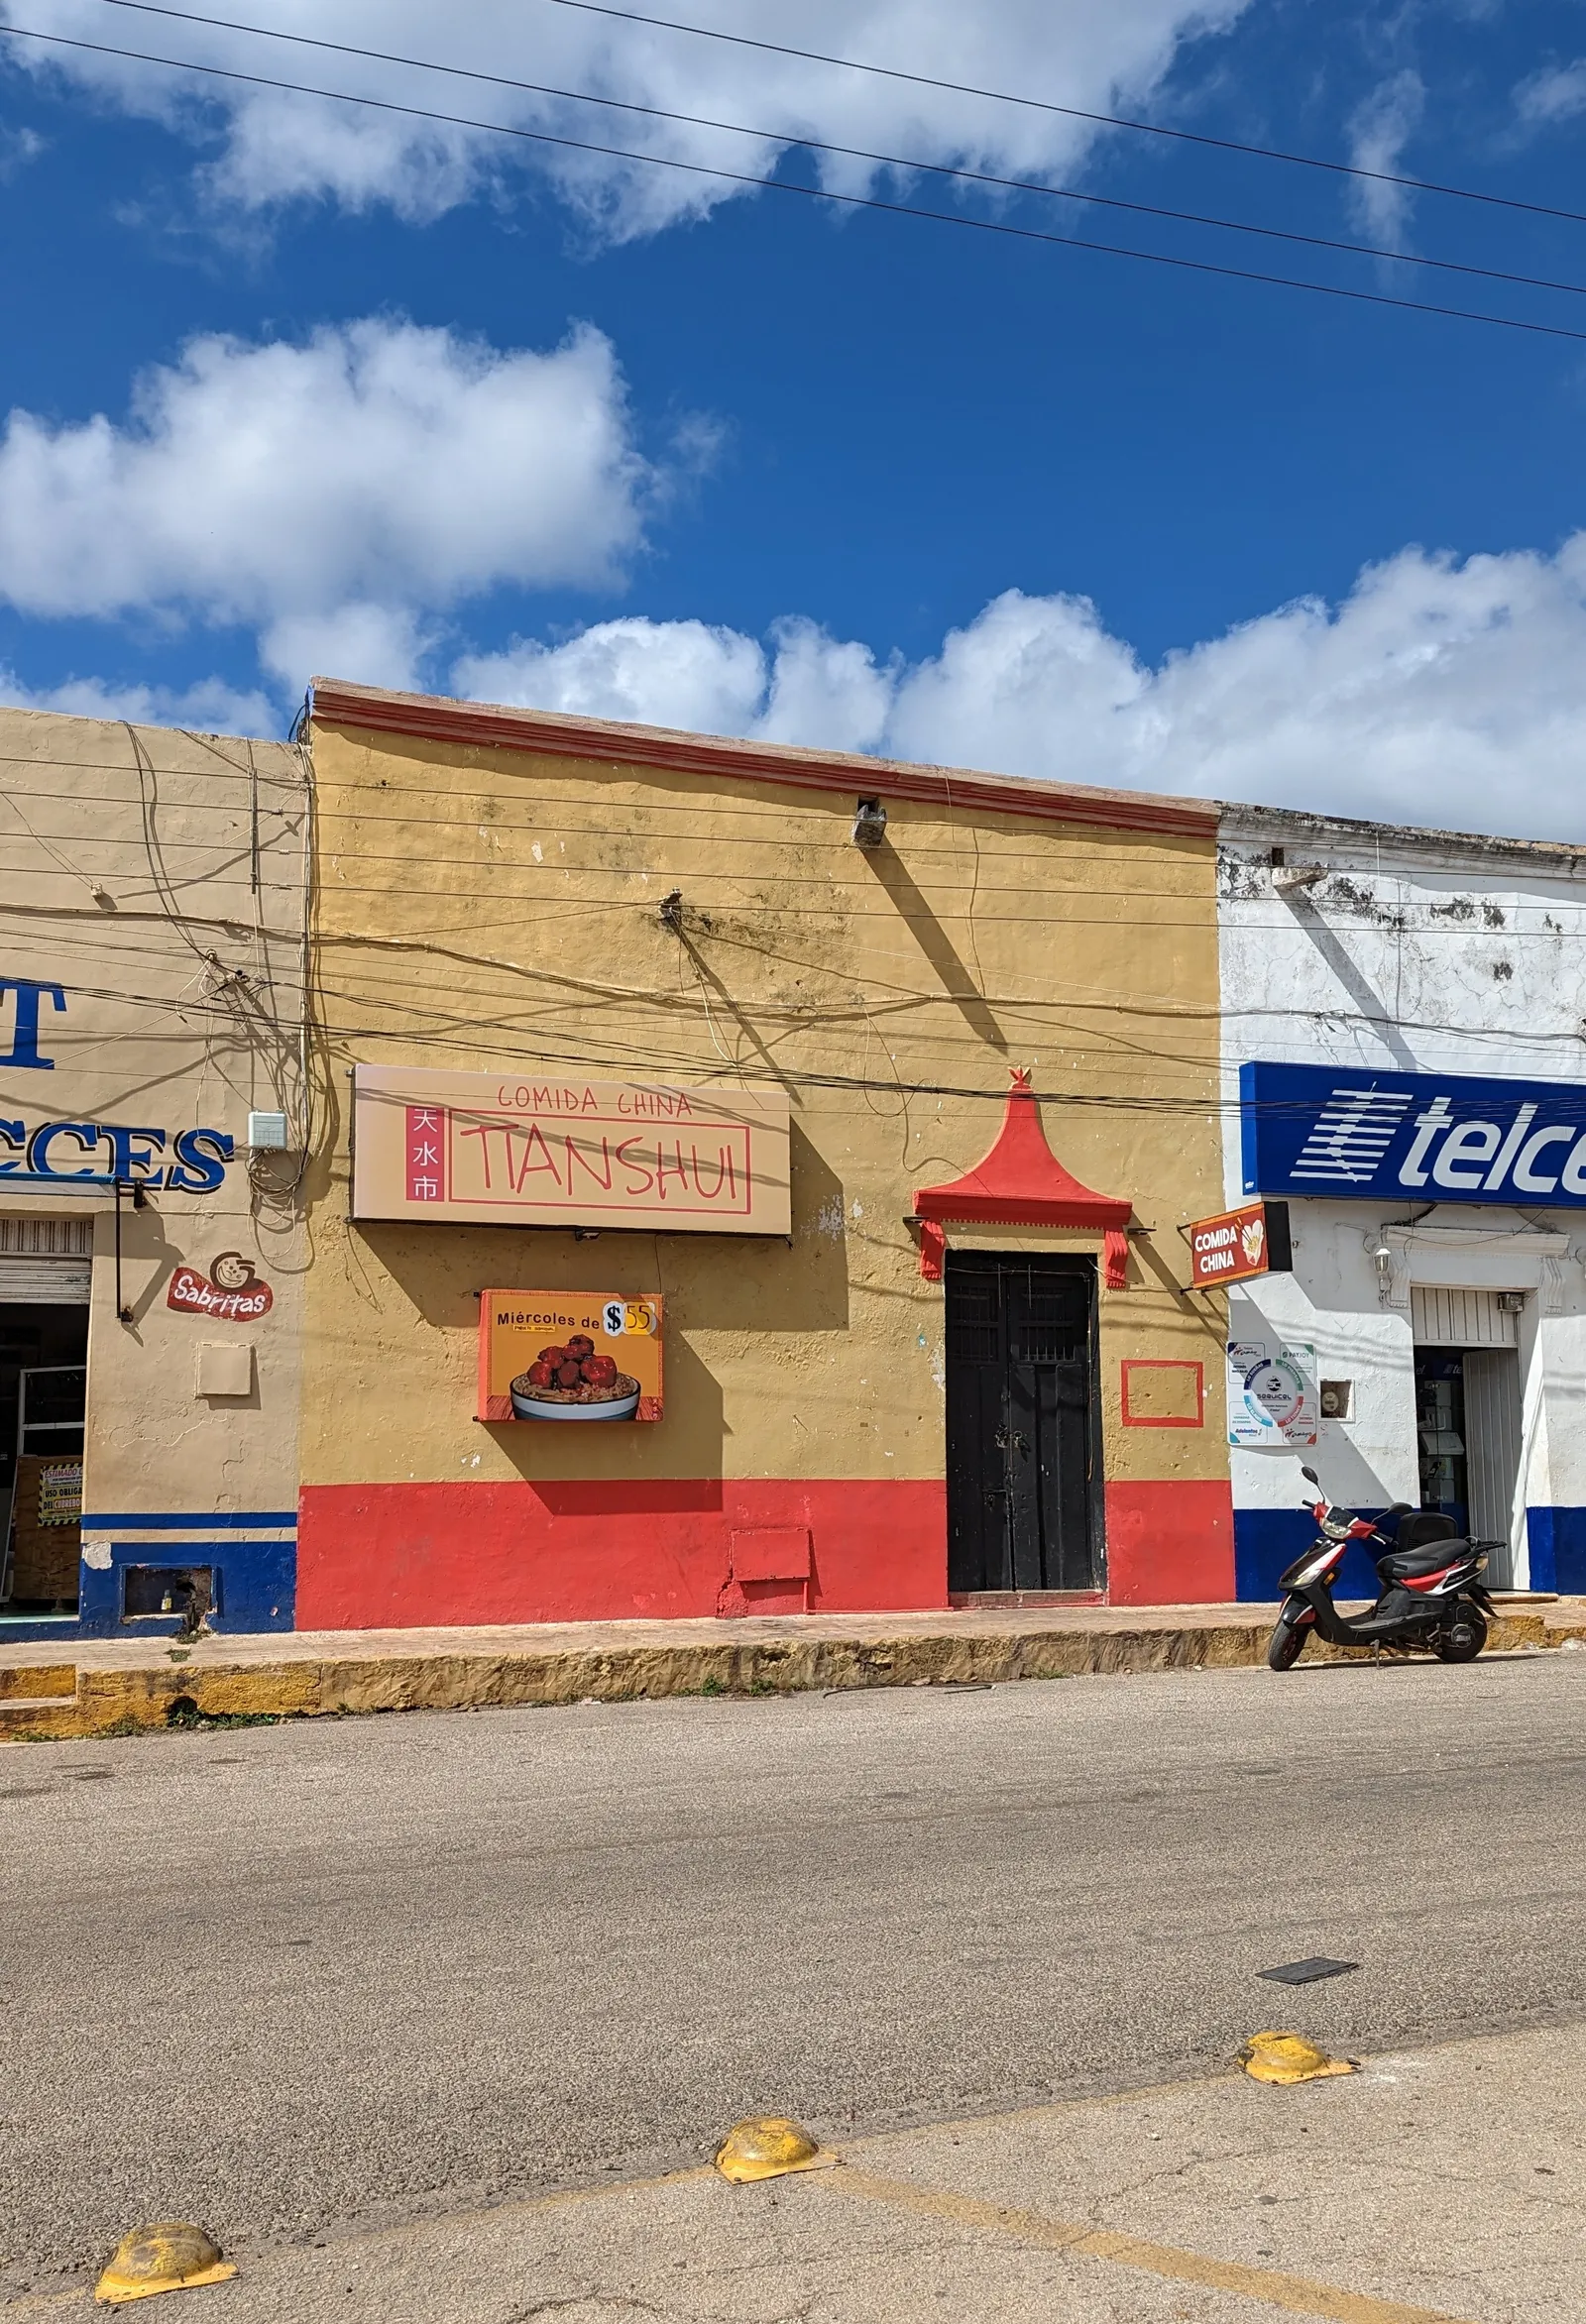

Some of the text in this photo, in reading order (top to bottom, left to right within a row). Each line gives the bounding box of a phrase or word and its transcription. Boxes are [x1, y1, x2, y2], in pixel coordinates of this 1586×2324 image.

[498, 1085, 692, 1118] COMIDA CHINA
[412, 1107, 438, 1201] 天水市
[460, 1123, 736, 1200] TIANSHUI
[1194, 1225, 1238, 1253] COMIDA
[1200, 1249, 1235, 1273] CHINA
[173, 1274, 266, 1314] Sabritas
[498, 1310, 576, 1326] Miércoles
[581, 1316, 600, 1329] de
[45, 1469, 77, 1478] ESTIMADO
[45, 1489, 57, 1497] USO
